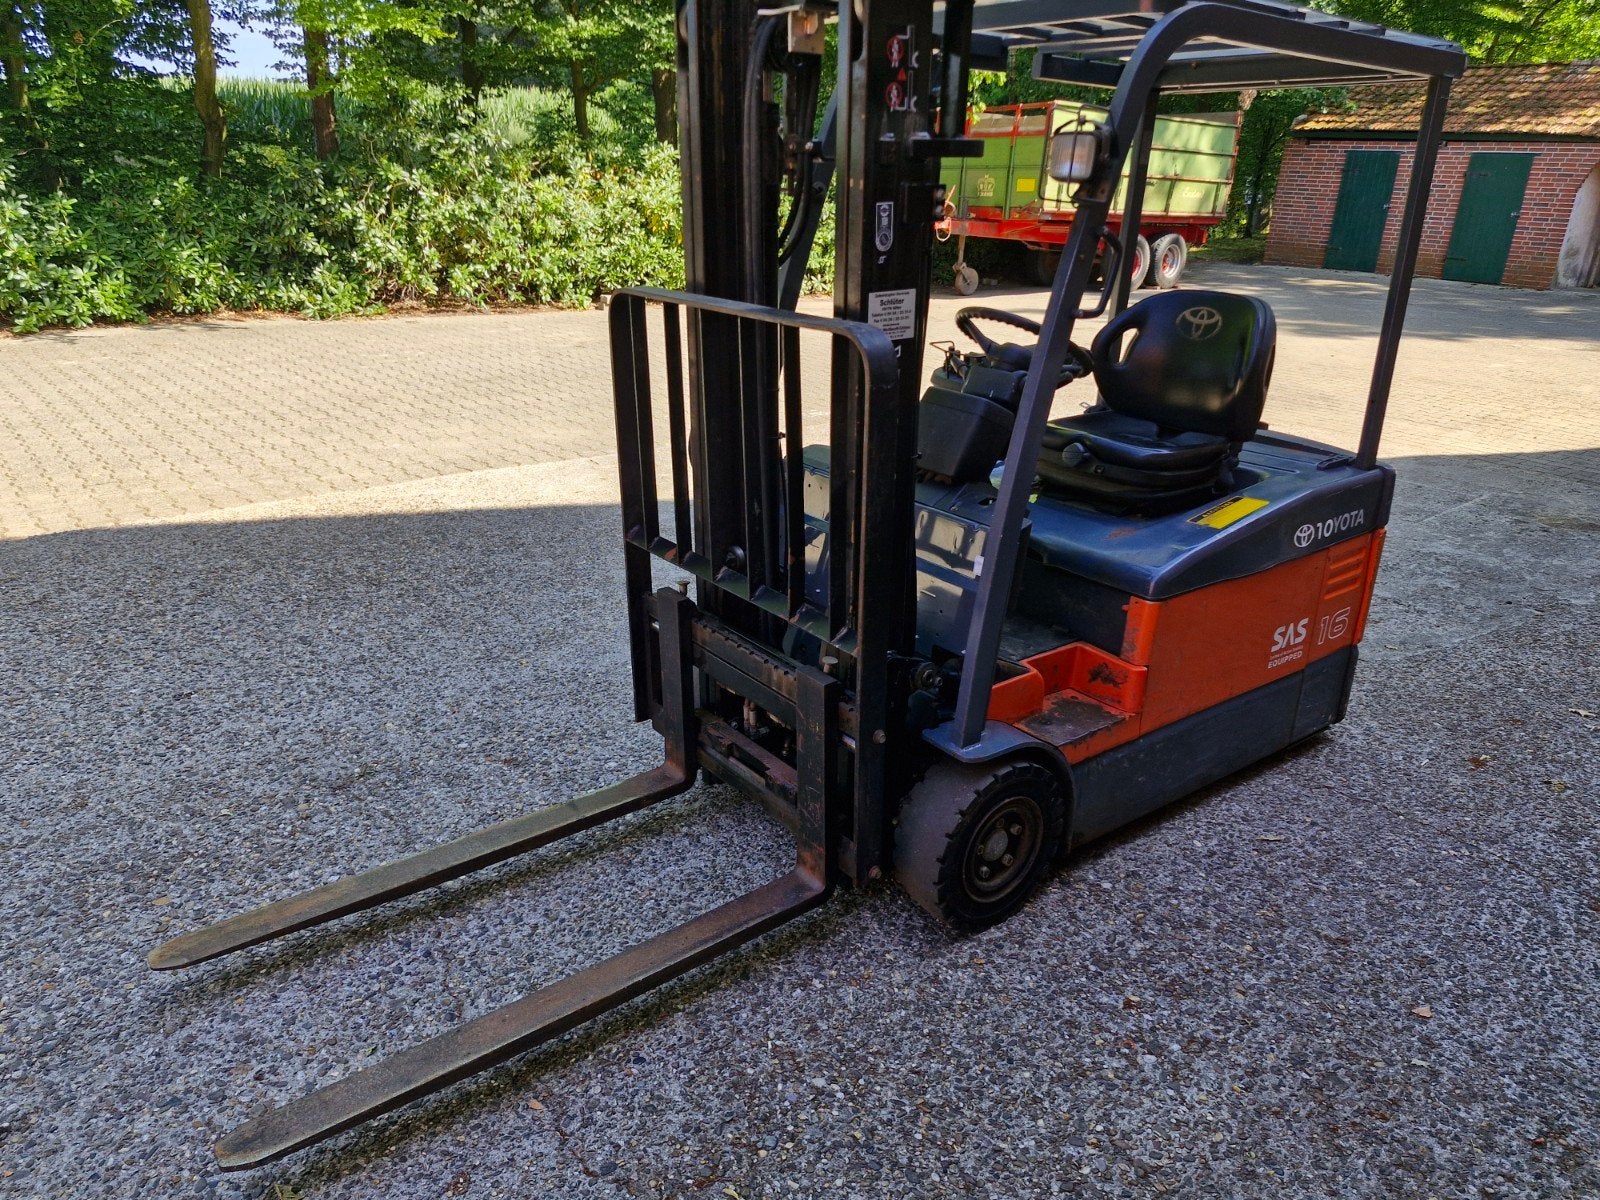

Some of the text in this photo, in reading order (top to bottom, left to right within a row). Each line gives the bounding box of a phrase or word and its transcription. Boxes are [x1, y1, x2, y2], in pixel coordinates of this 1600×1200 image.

[1271, 618, 1309, 652] SAS
[1318, 607, 1351, 645] 16
[1268, 651, 1303, 668] EQUIPPED
